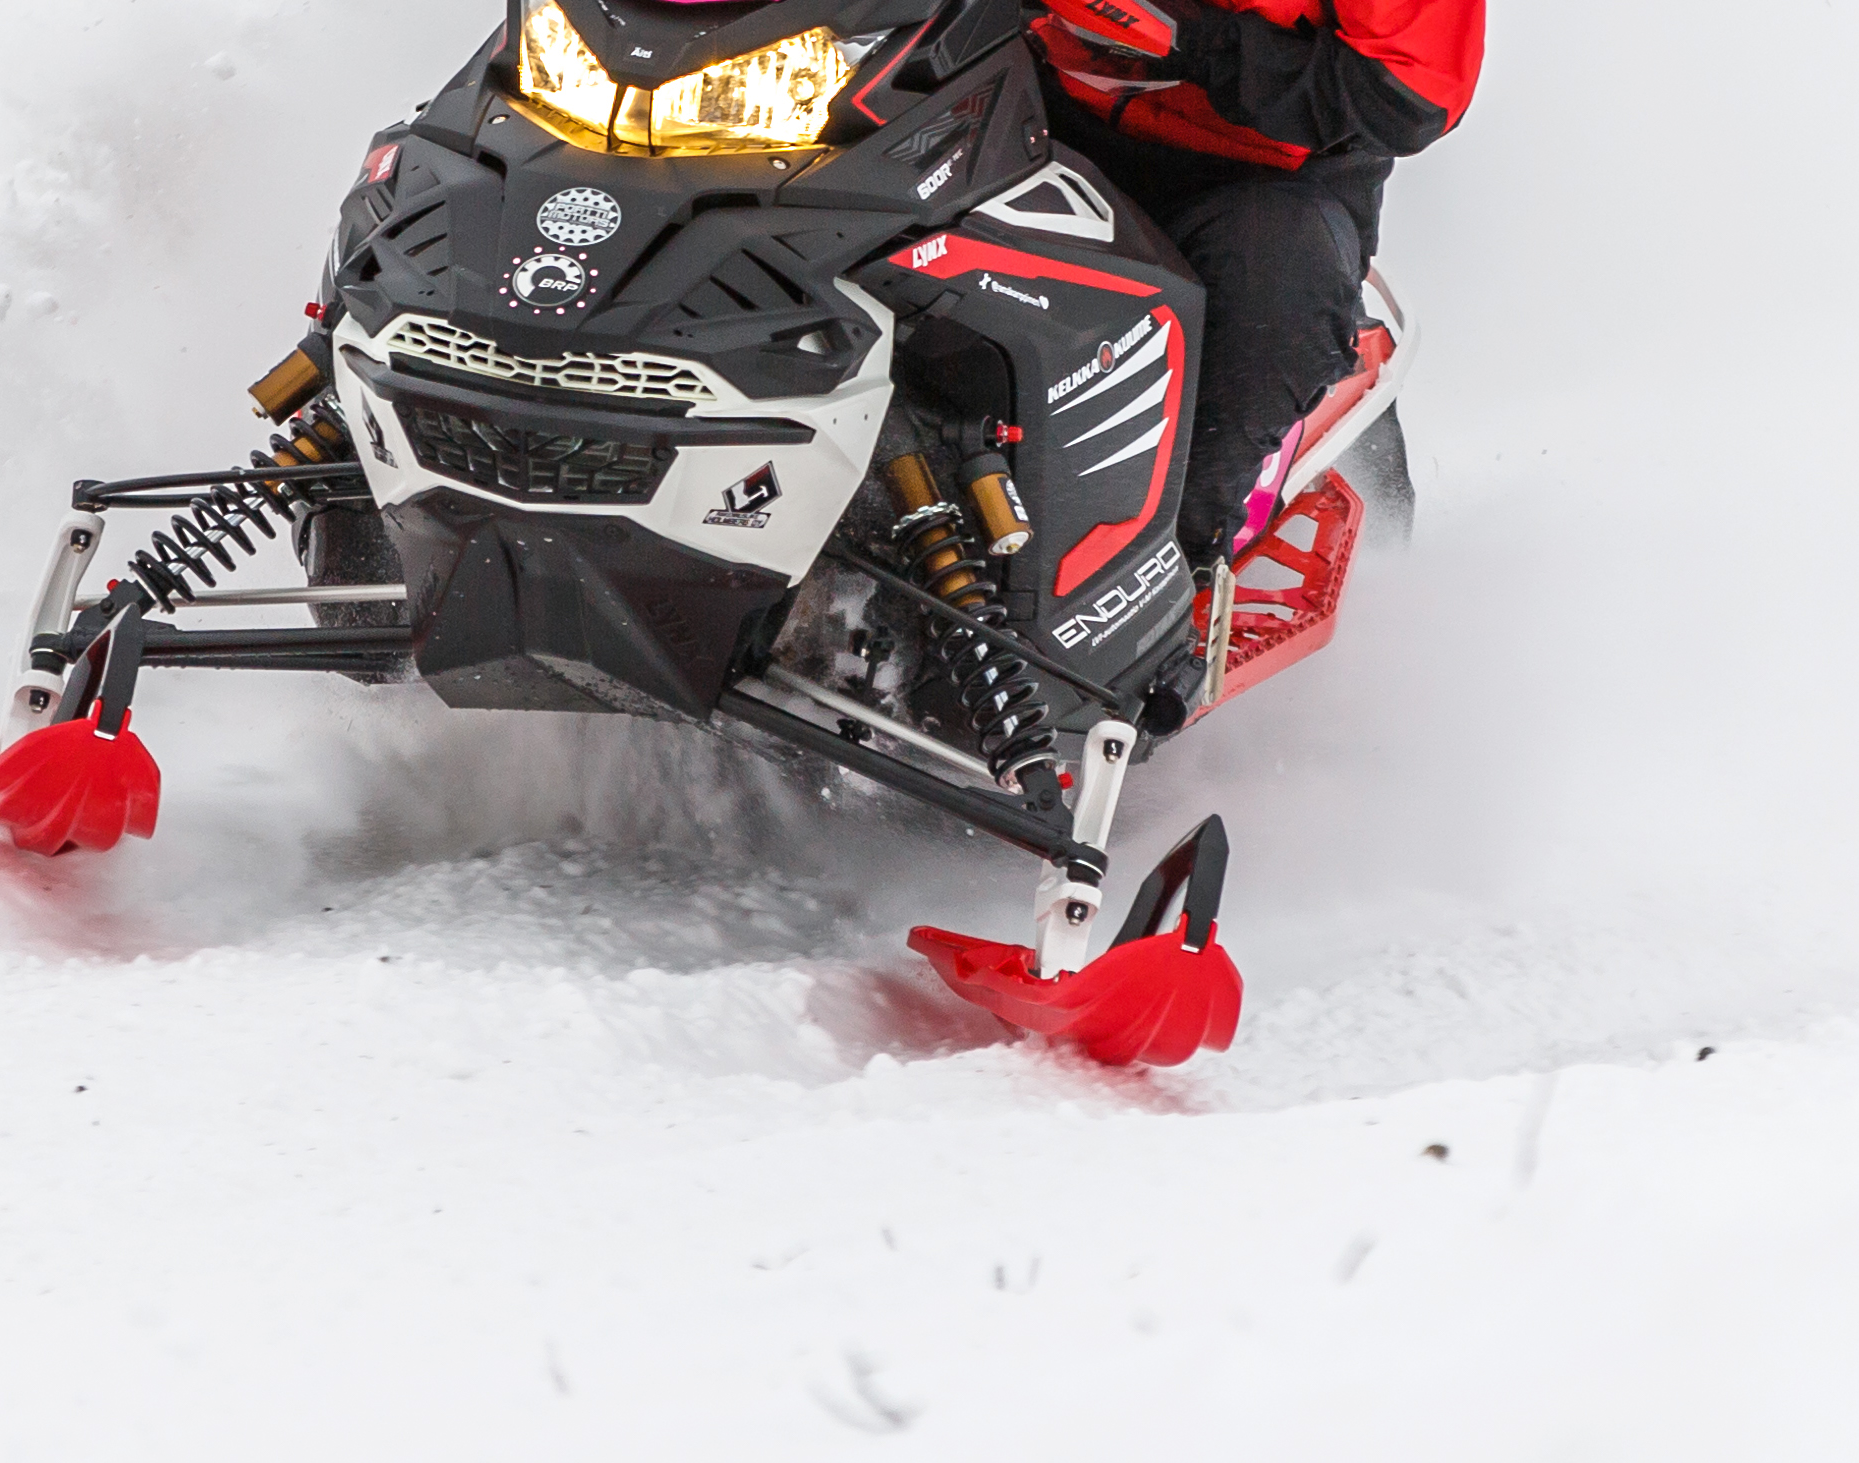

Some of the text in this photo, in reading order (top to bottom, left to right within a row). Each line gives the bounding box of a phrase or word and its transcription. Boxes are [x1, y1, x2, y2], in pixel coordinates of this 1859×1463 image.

[917, 163, 952, 200] 600R
[912, 235, 948, 269] LYNX
[538, 278, 579, 291] BRP
[1047, 314, 1153, 404] KELKKA KUUME
[1052, 540, 1181, 649] ENDURO
